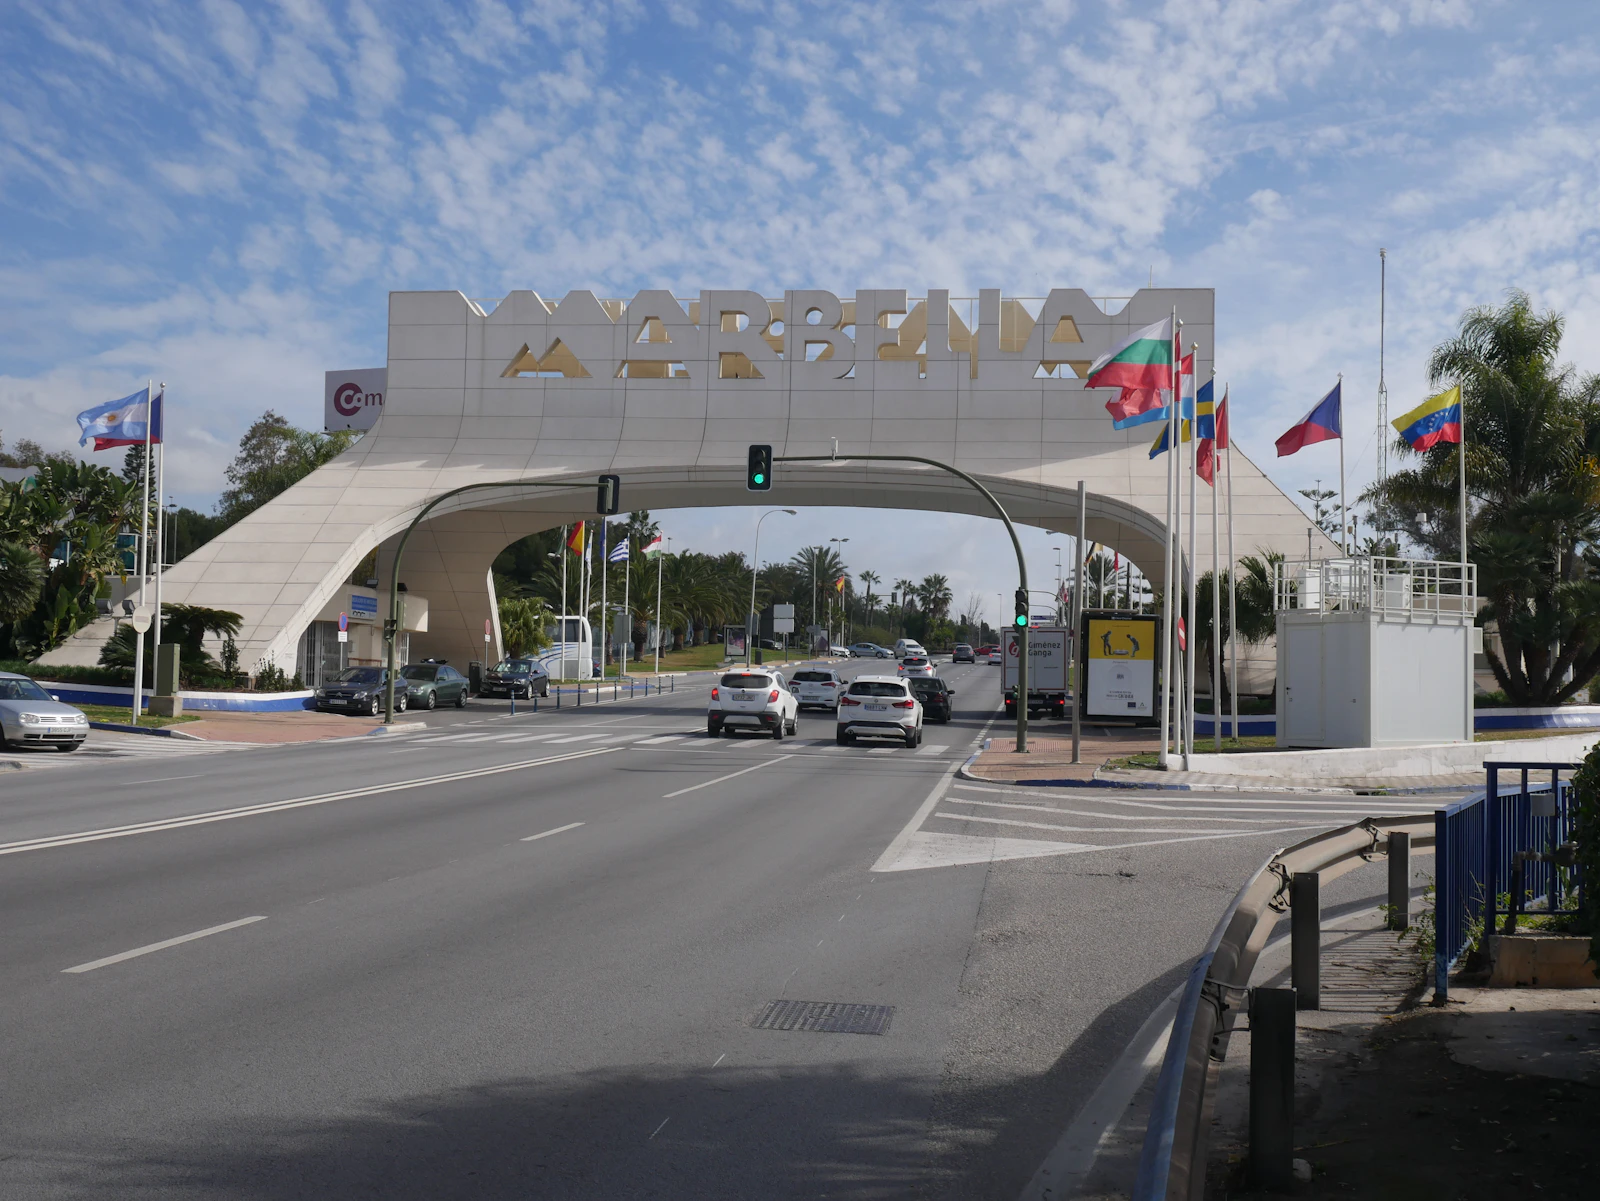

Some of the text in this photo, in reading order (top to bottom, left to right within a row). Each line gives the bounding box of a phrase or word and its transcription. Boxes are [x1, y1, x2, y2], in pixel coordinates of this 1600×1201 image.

[486, 288, 1112, 379] MARBELLA
[1028, 641, 1061, 649] Giménez
[1028, 649, 1052, 658] Ganga
